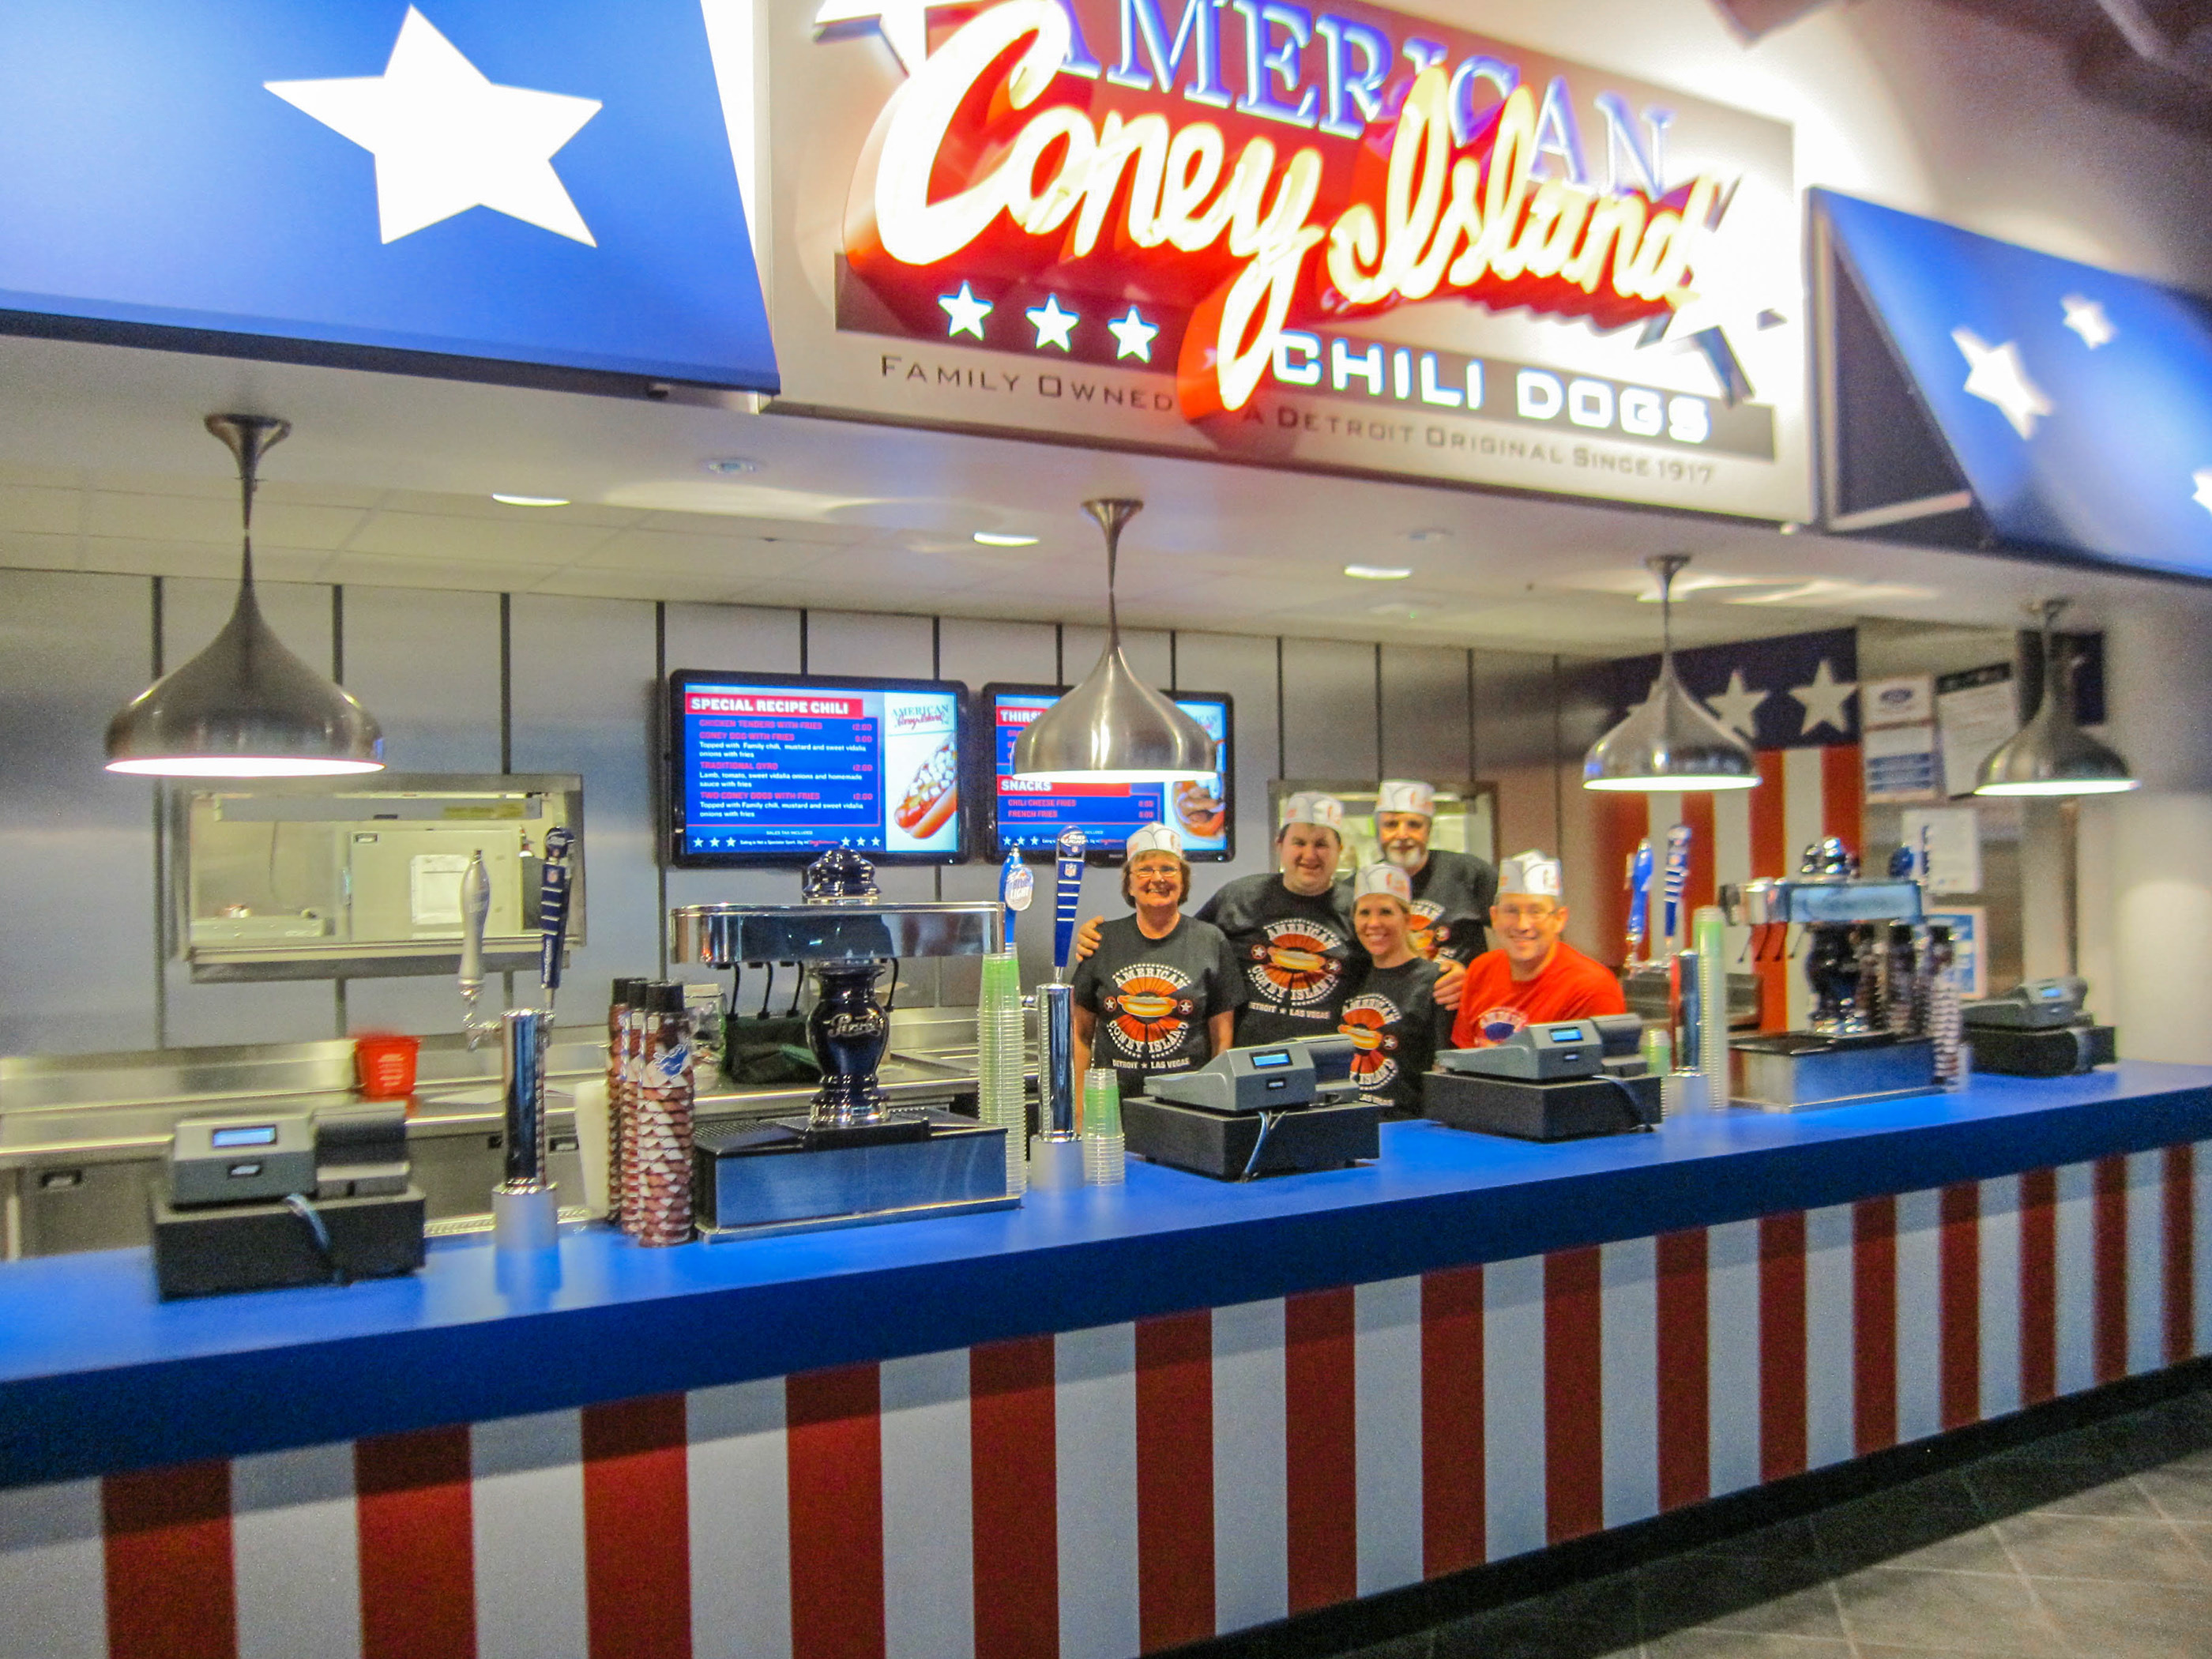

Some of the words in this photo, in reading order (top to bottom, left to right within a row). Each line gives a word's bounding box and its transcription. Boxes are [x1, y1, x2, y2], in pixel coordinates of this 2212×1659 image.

[875, 0, 1326, 411] Coney
[1326, 65, 1706, 304] Island
[1273, 330, 1484, 410] CHILI
[1516, 367, 1712, 444] DOGS
[1657, 461, 1714, 484] 1917
[690, 698, 754, 711] SPECIAL
[756, 700, 808, 713] RECIPE
[810, 702, 849, 714] CHILI
[893, 704, 949, 717] AMERICAN
[1000, 709, 1044, 722] THIRS
[699, 741, 724, 750] Topped
[743, 742, 765, 750] Family
[1001, 780, 1053, 791] SNACKS
[741, 801, 764, 810] Family
[1267, 923, 1337, 950] AMERICAN
[1115, 967, 1189, 990] AMERICAN
[1251, 964, 1288, 999] CONEY
[1290, 973, 1335, 1001] ISLAND
[1289, 1009, 1306, 1018] LAS
[1107, 1019, 1146, 1052] CONEY
[1147, 1021, 1189, 1054] ISLAND
[1112, 1059, 1138, 1069] DETROIT
[1150, 1060, 1167, 1069] LAS
[1168, 1057, 1190, 1068] VEGAS
[1359, 1057, 1396, 1086] ISLAND
